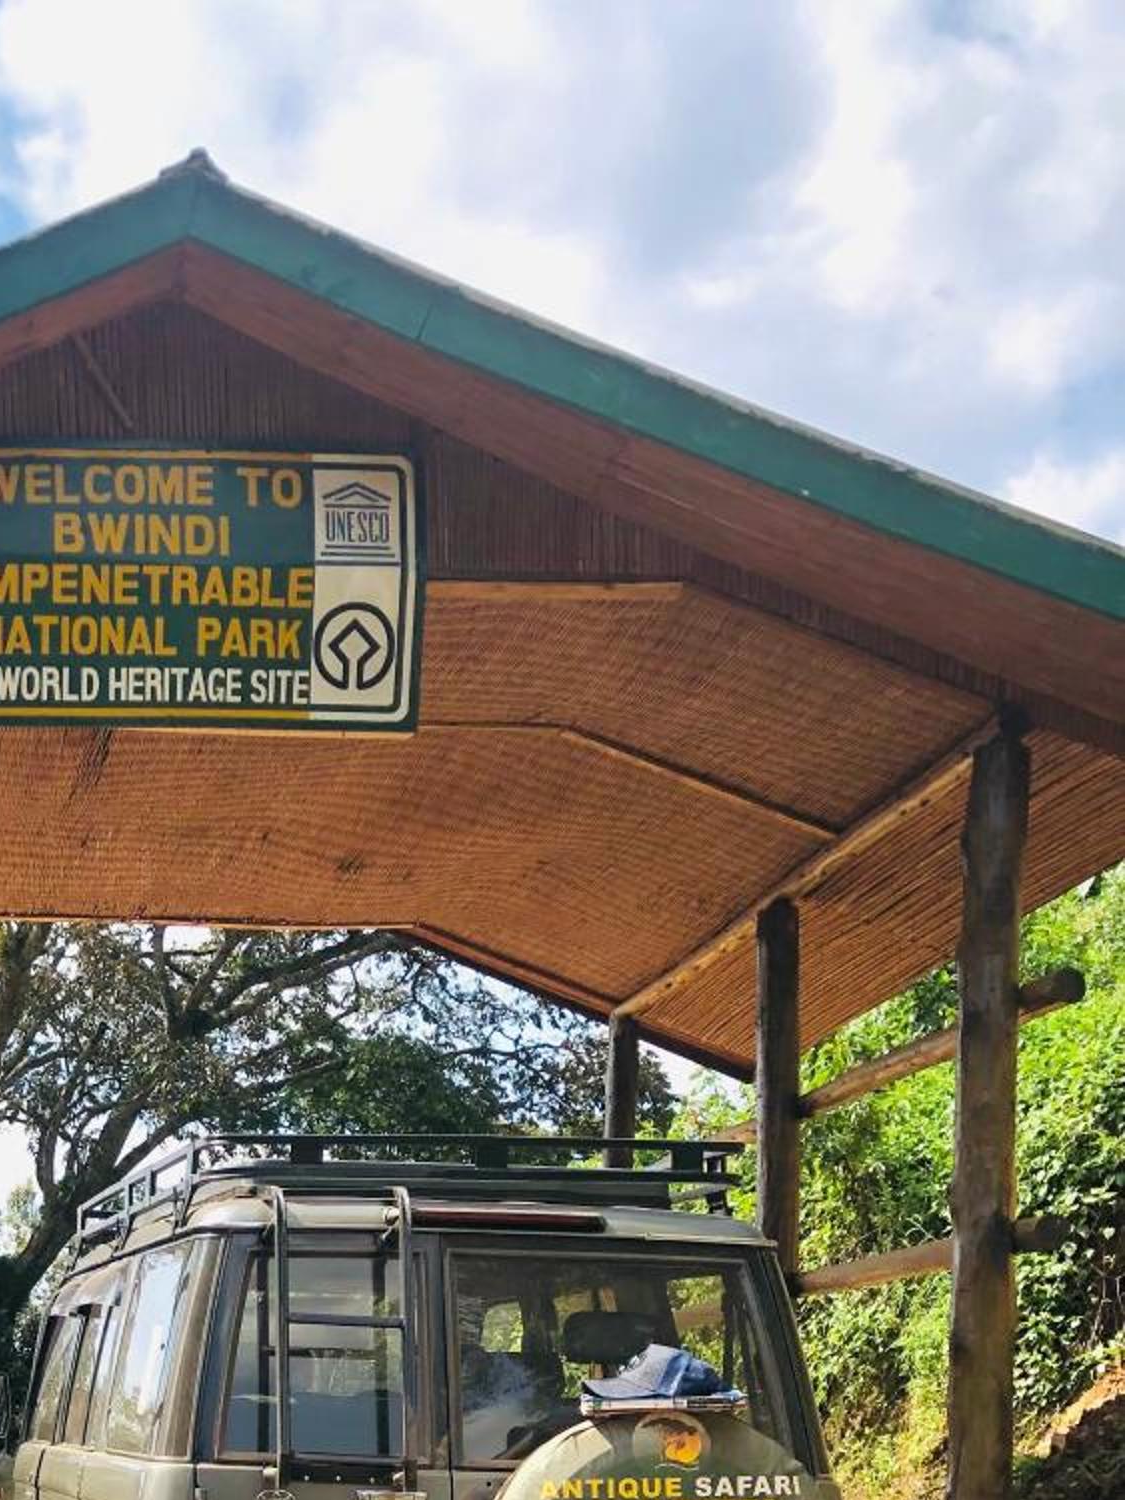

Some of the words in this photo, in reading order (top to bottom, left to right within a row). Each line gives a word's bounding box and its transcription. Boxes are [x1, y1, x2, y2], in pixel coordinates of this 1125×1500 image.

[237, 468, 302, 508] TO
[54, 512, 229, 556] BWINDI
[326, 511, 389, 543] UNESCO
[197, 617, 302, 658] PARK
[109, 667, 242, 702] HERITAGE
[250, 669, 309, 704] SITE
[540, 1477, 683, 1500] ANTIQUE
[695, 1475, 801, 1497] SAFARI
